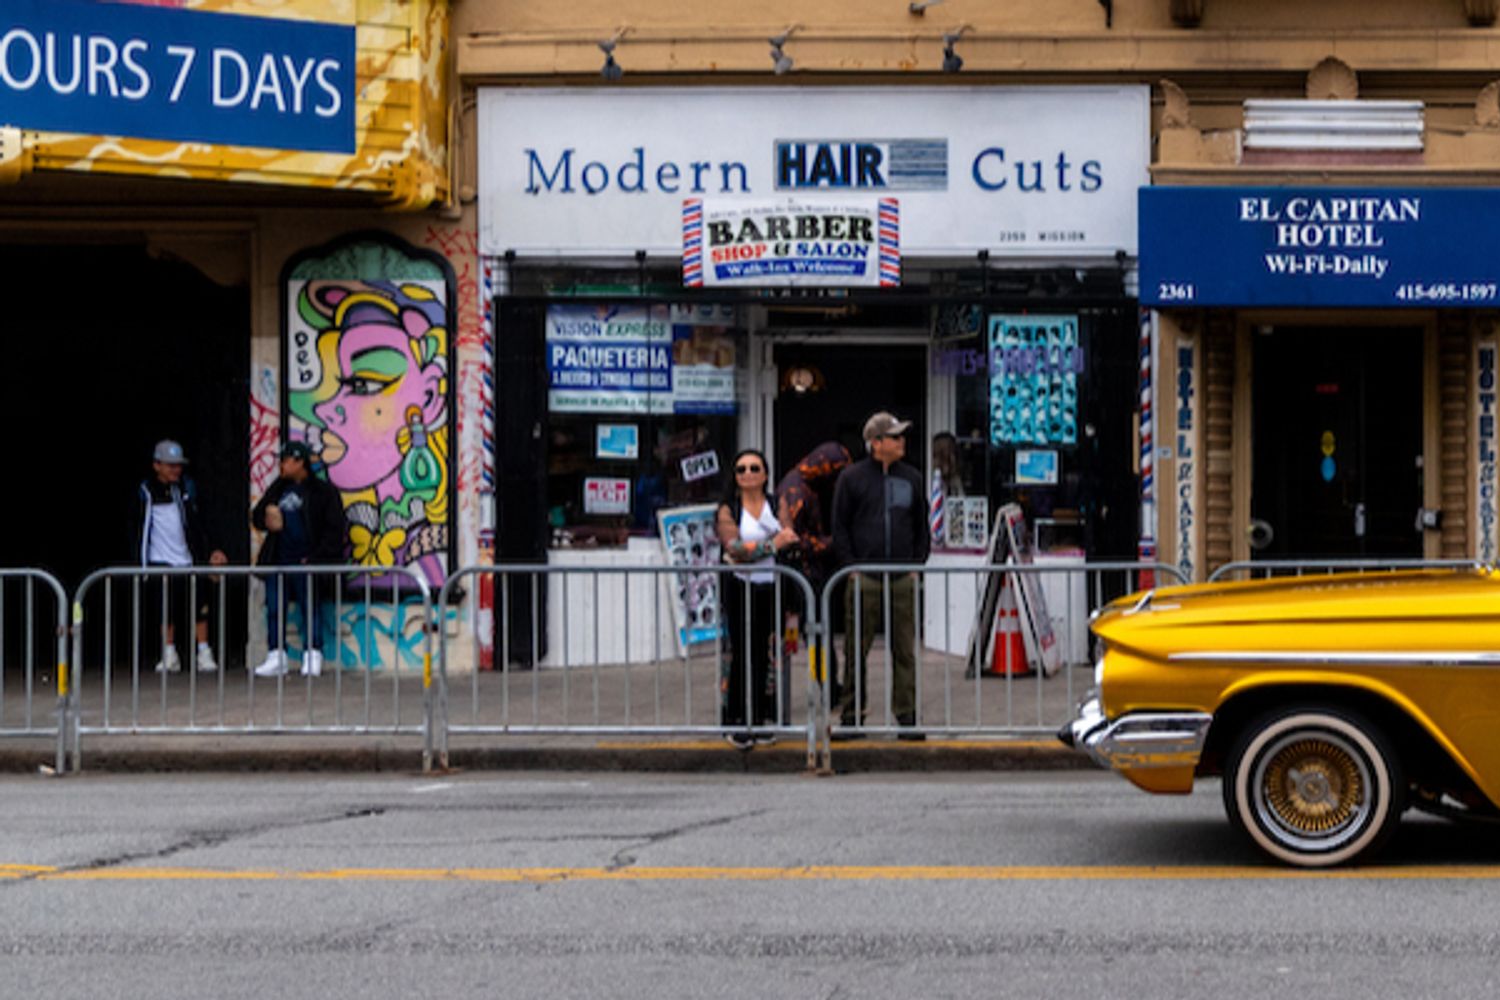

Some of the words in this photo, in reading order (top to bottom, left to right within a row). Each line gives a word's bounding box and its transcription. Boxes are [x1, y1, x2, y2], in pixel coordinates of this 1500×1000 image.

[166, 46, 197, 102] 7
[211, 47, 343, 118] DAYS
[524, 147, 751, 194] Modern
[776, 143, 889, 187] HAIR
[971, 147, 1104, 193] Cuts
[1240, 199, 1278, 222] EL
[1286, 197, 1421, 222] CAPITAN
[707, 214, 875, 247] BARBER
[1277, 224, 1384, 248] HOTEL
[710, 244, 768, 264] SHOP
[796, 242, 869, 259] SALON
[1265, 254, 1389, 278] Wi-Fi-Daily
[1158, 284, 1195, 300] 2361
[1395, 284, 1497, 300] 415-695-1597
[605, 322, 667, 337] EXPRESS
[552, 345, 669, 369] PAQUETERIA
[1478, 349, 1495, 463] HOTEL
[684, 456, 715, 476] OPEN
